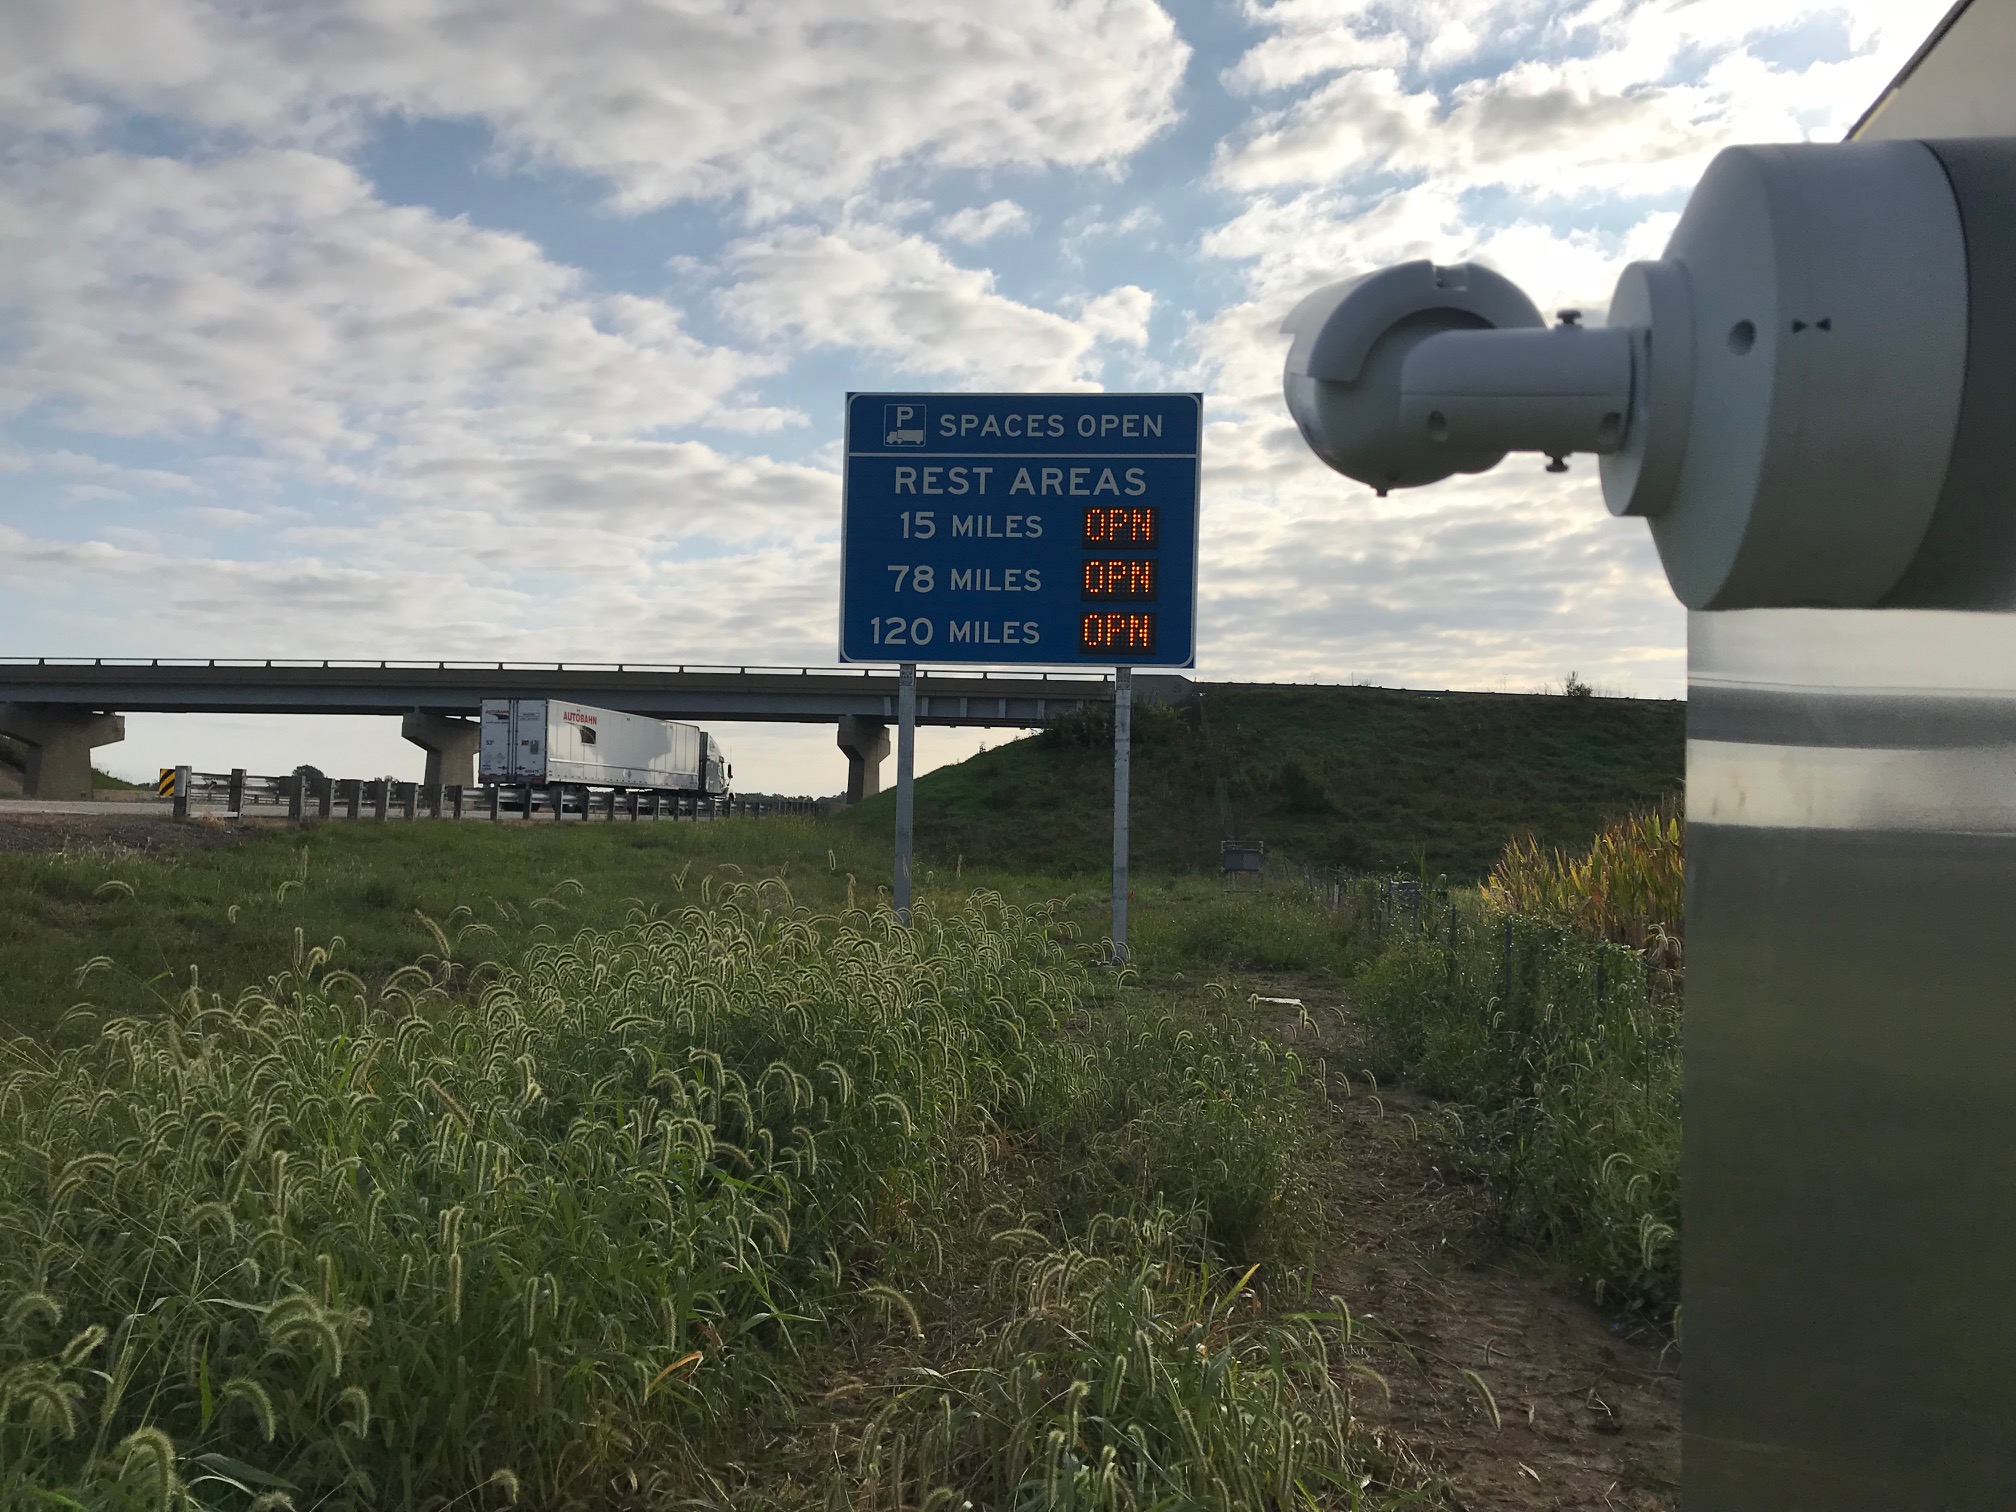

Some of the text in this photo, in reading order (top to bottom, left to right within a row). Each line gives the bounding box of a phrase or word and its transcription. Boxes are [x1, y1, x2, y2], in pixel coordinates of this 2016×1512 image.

[896, 406, 914, 428] P
[939, 414, 1162, 437] SPACES OPEN
[895, 466, 1146, 496] REST AREAS
[900, 511, 1043, 539] 15 MILES
[1085, 508, 1151, 541] OPN
[887, 565, 1042, 593] 78 MILES
[1084, 561, 1150, 593] OPN
[870, 616, 1040, 646] 120 MILES
[1083, 614, 1149, 647] OPN
[563, 711, 598, 725] AUTOBAHN
